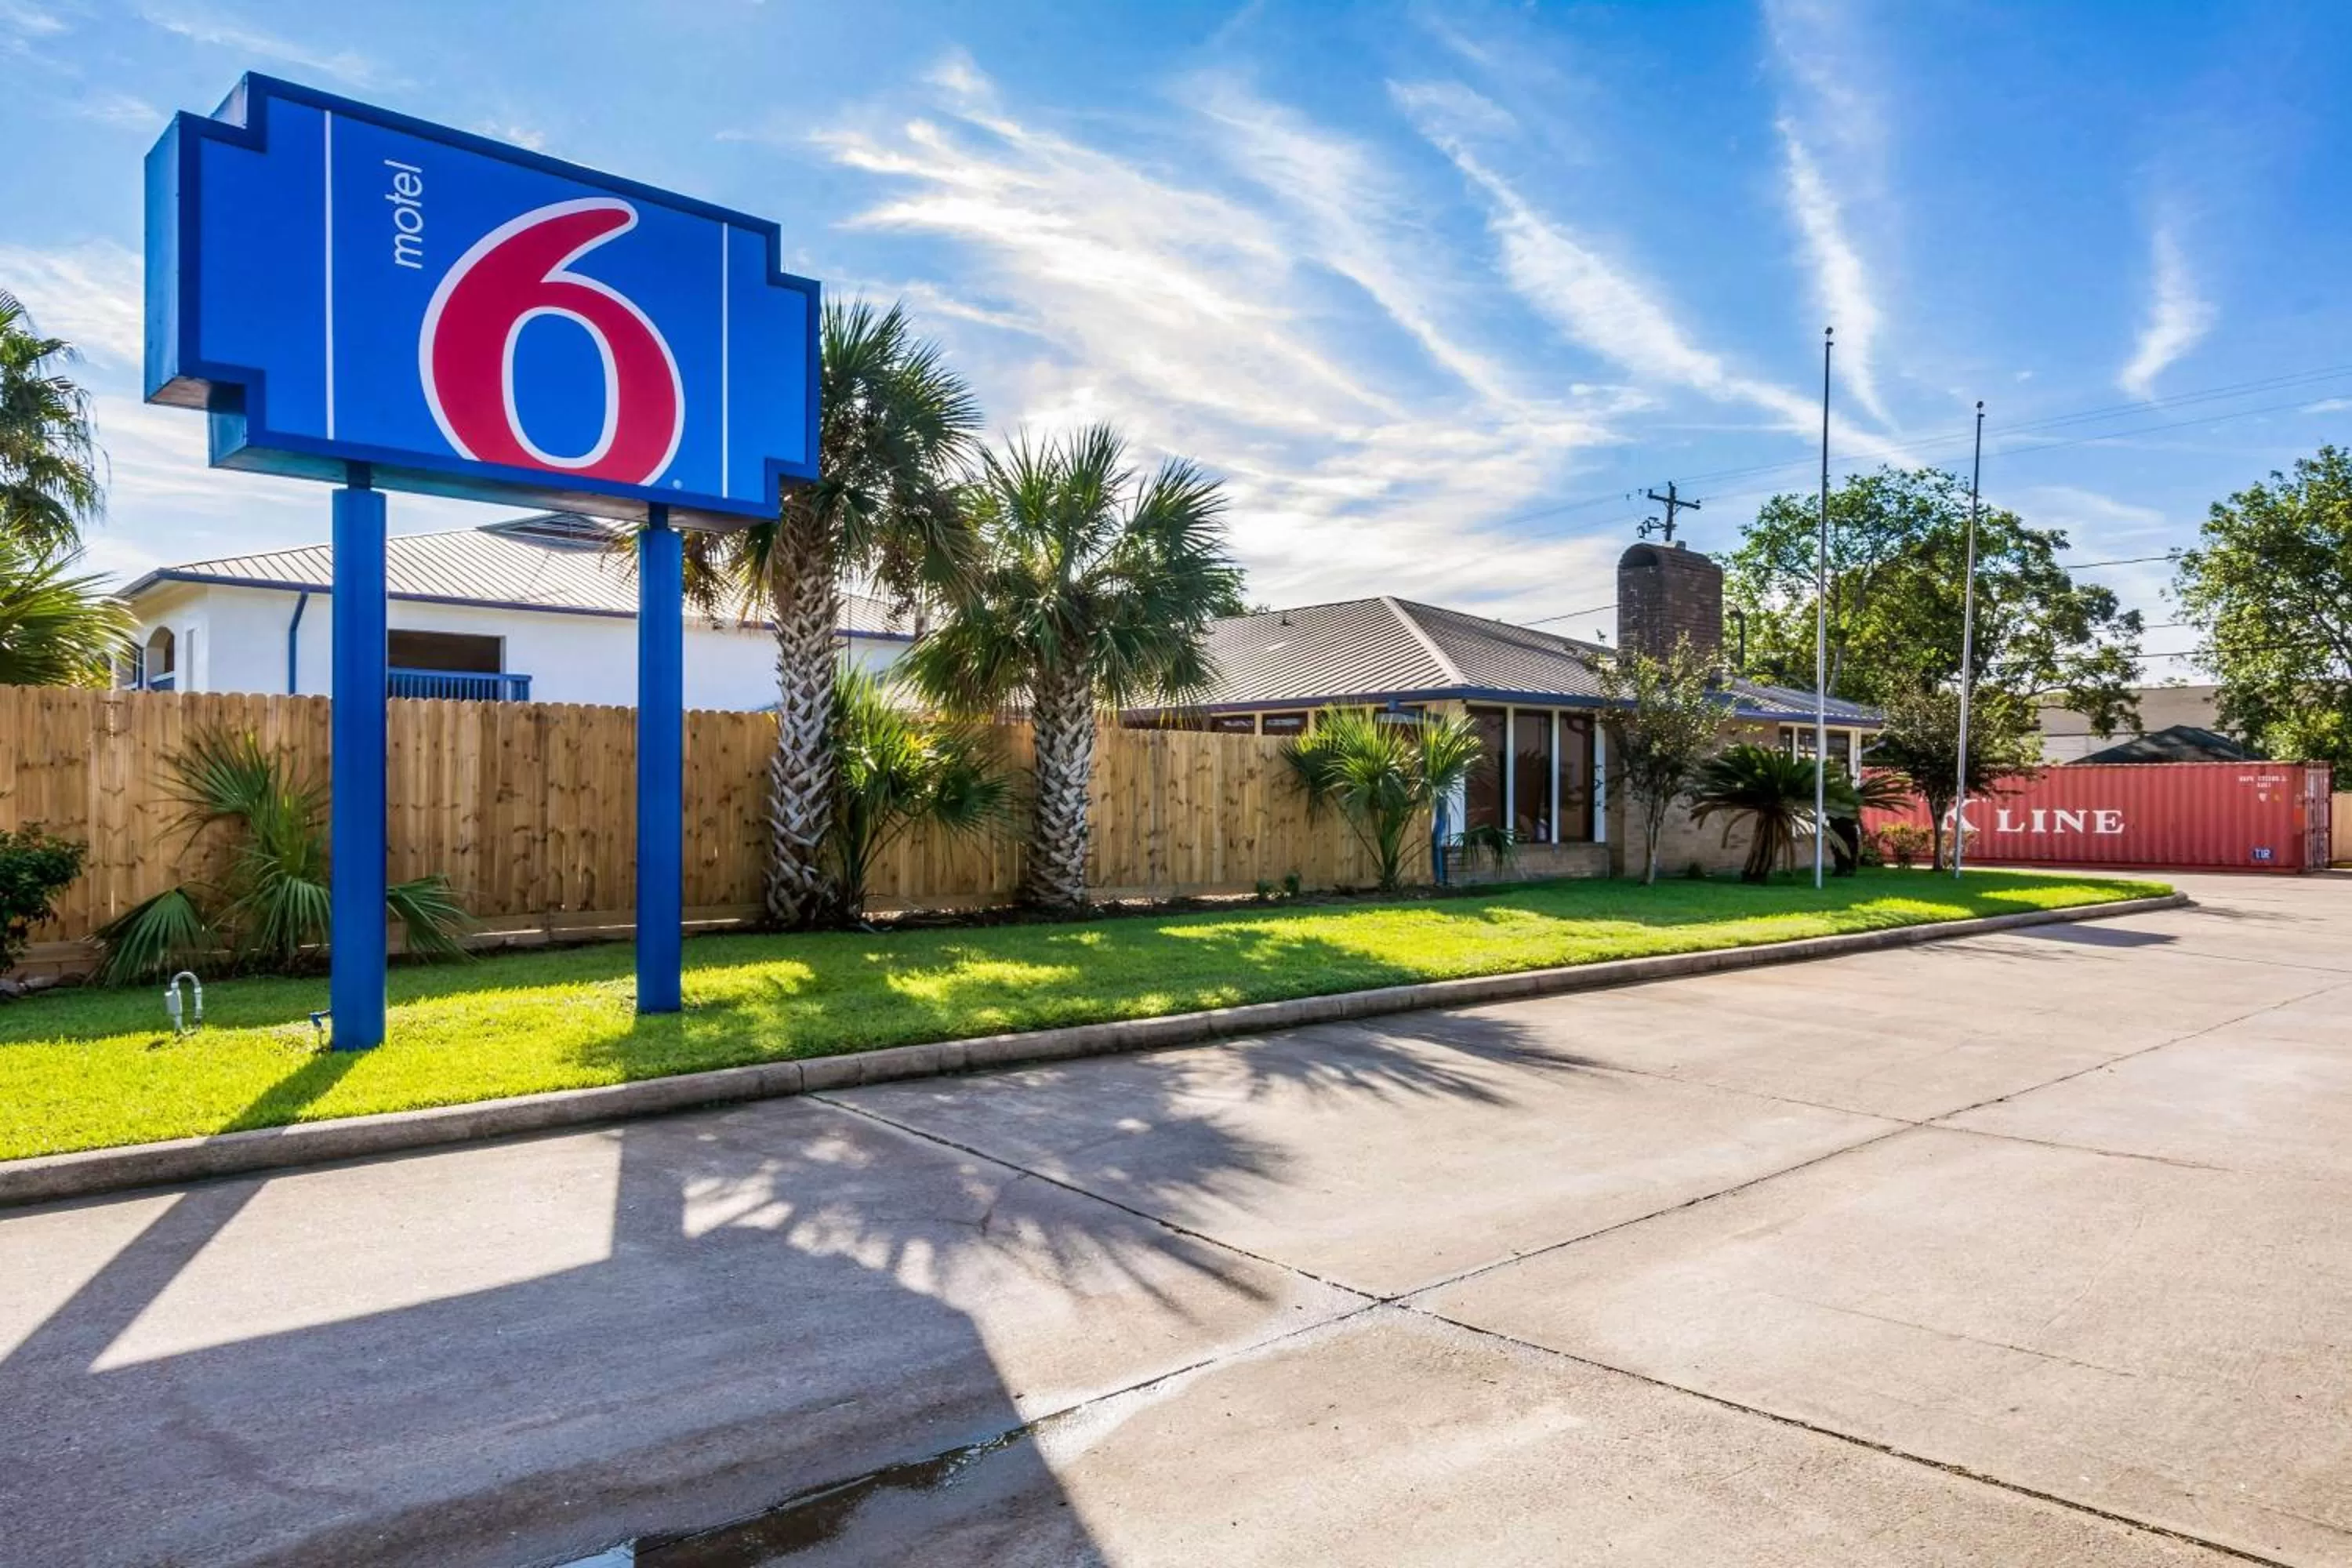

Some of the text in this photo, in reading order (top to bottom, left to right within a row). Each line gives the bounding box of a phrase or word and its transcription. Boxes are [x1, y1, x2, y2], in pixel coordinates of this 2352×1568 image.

[384, 159, 423, 269] motel
[418, 197, 685, 487] 6
[1996, 808, 2125, 833] LINE
